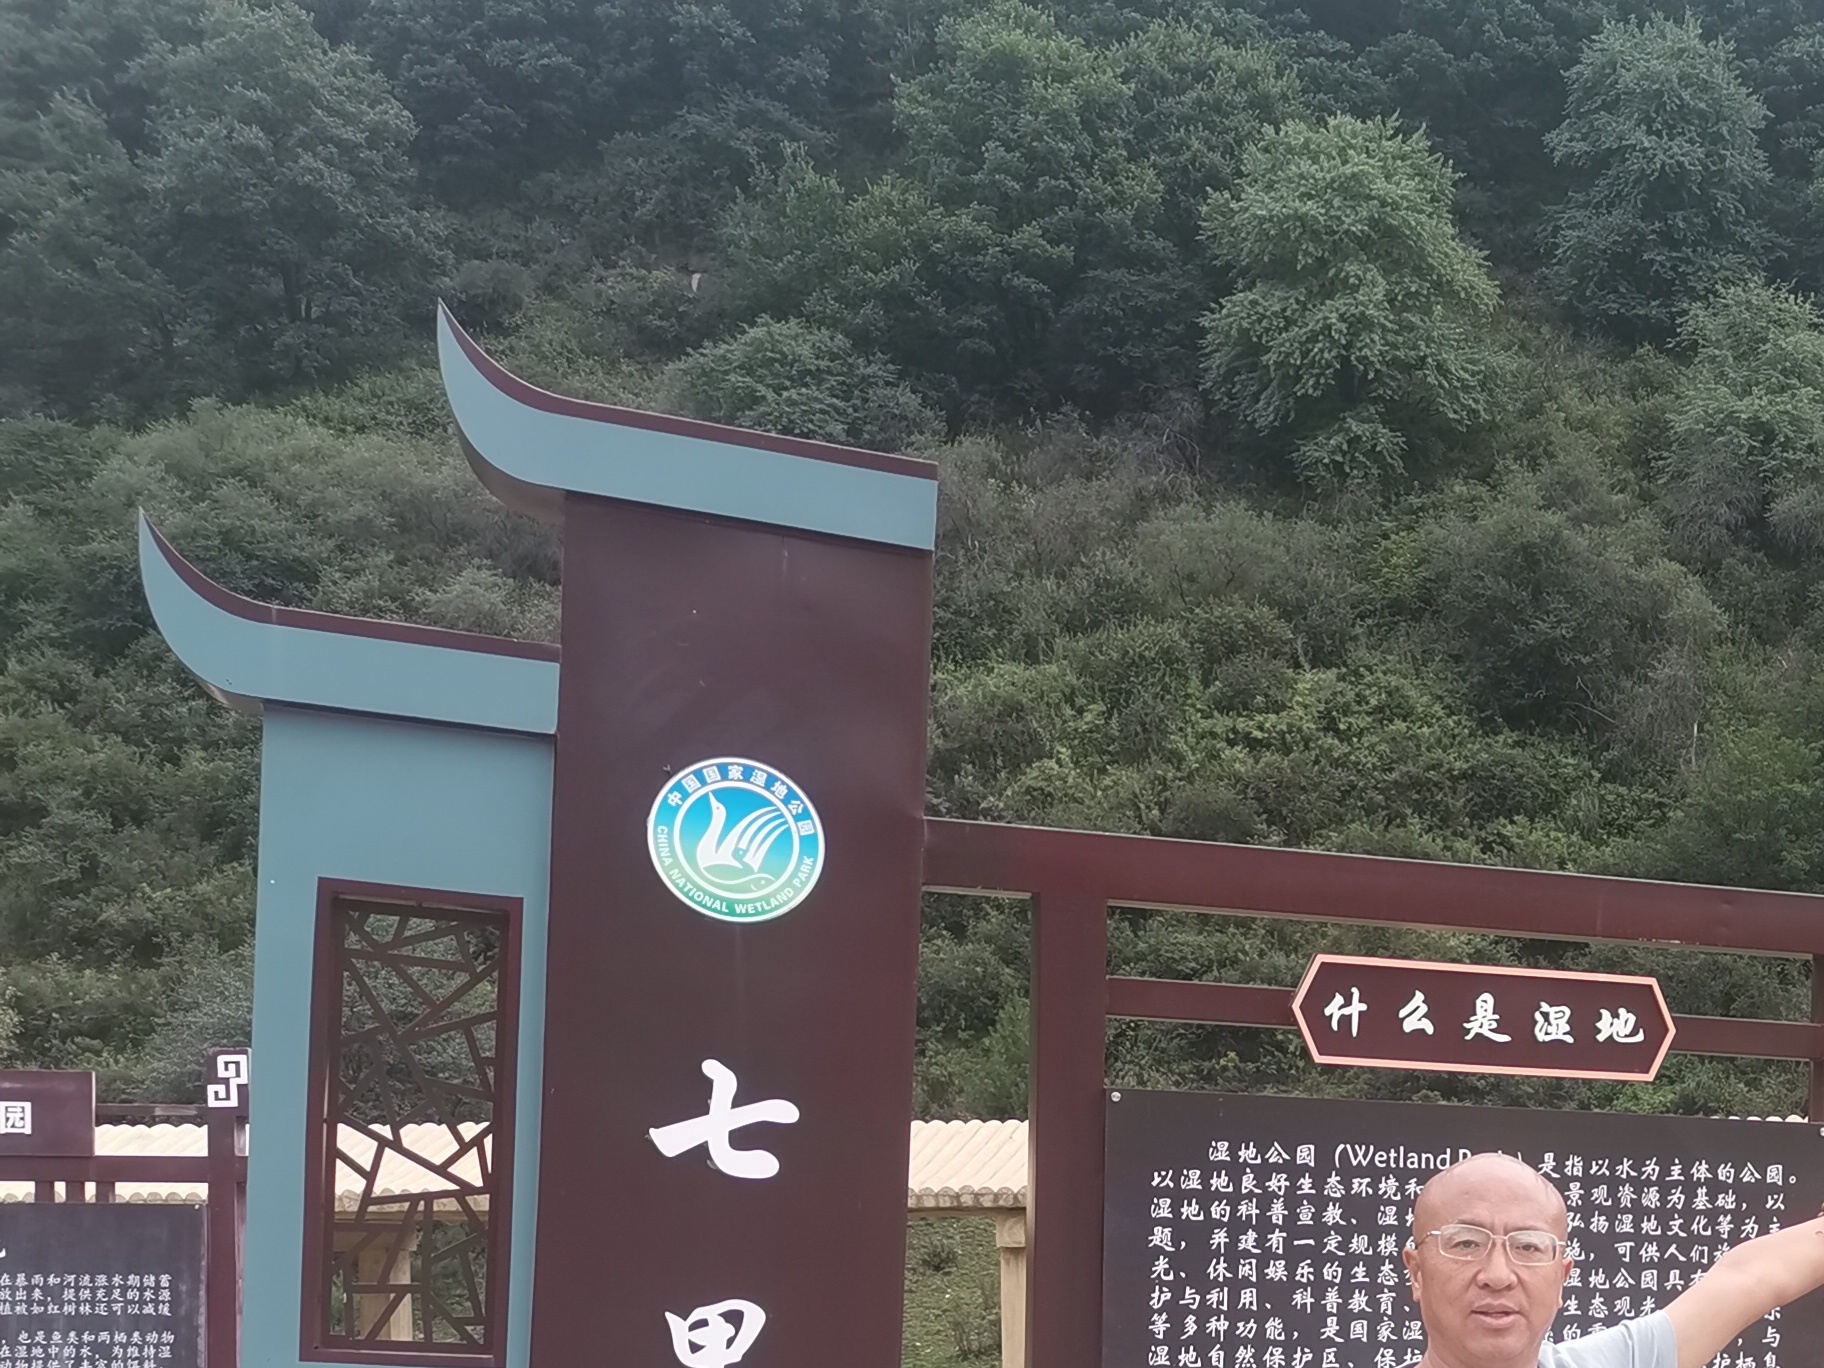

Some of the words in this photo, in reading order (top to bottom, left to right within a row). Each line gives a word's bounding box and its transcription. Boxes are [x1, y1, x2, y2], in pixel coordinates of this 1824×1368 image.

[657, 825, 670, 866] CHINA
[669, 868, 729, 913] NATIONAL
[734, 887, 794, 914] WETLAND
[794, 856, 815, 888] PARK
[1323, 987, 1645, 1043] 什么是湿地
[1151, 1256, 1411, 1286] 光、休闲娱乐的生态
